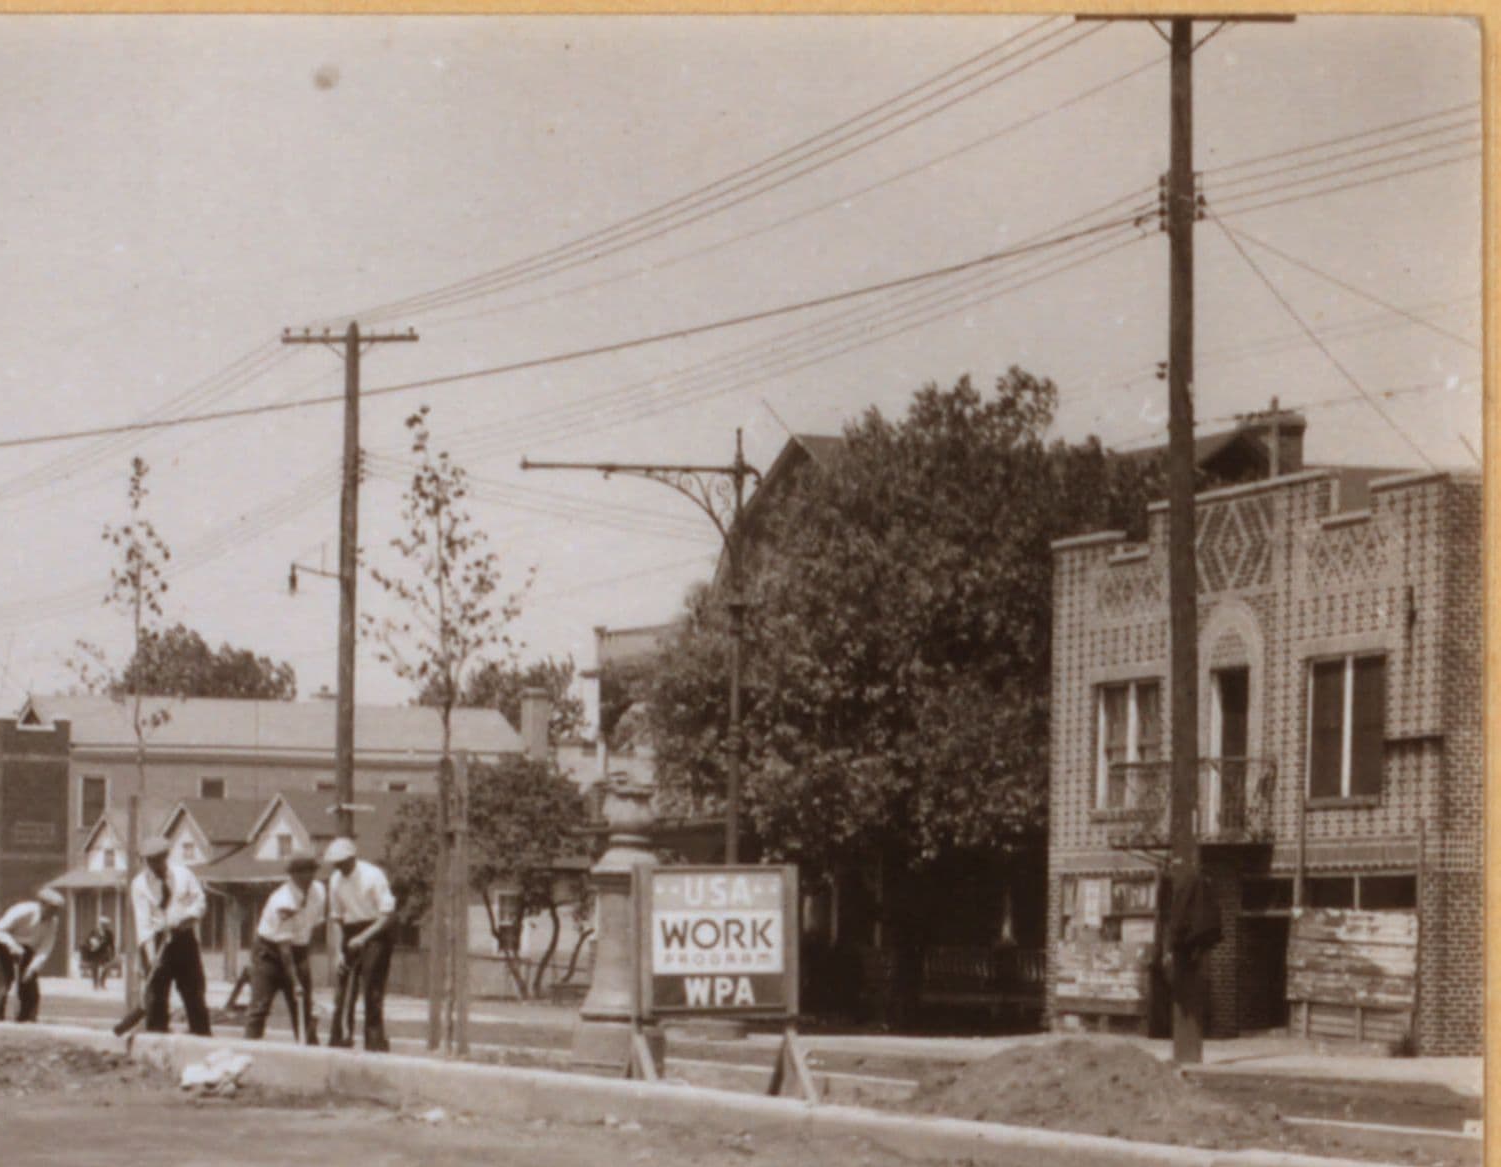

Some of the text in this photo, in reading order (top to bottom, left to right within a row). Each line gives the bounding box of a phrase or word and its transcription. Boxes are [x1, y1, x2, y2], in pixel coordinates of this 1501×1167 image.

[684, 875, 752, 905] USA
[660, 918, 773, 949] WORK
[684, 976, 755, 1007] WPA
